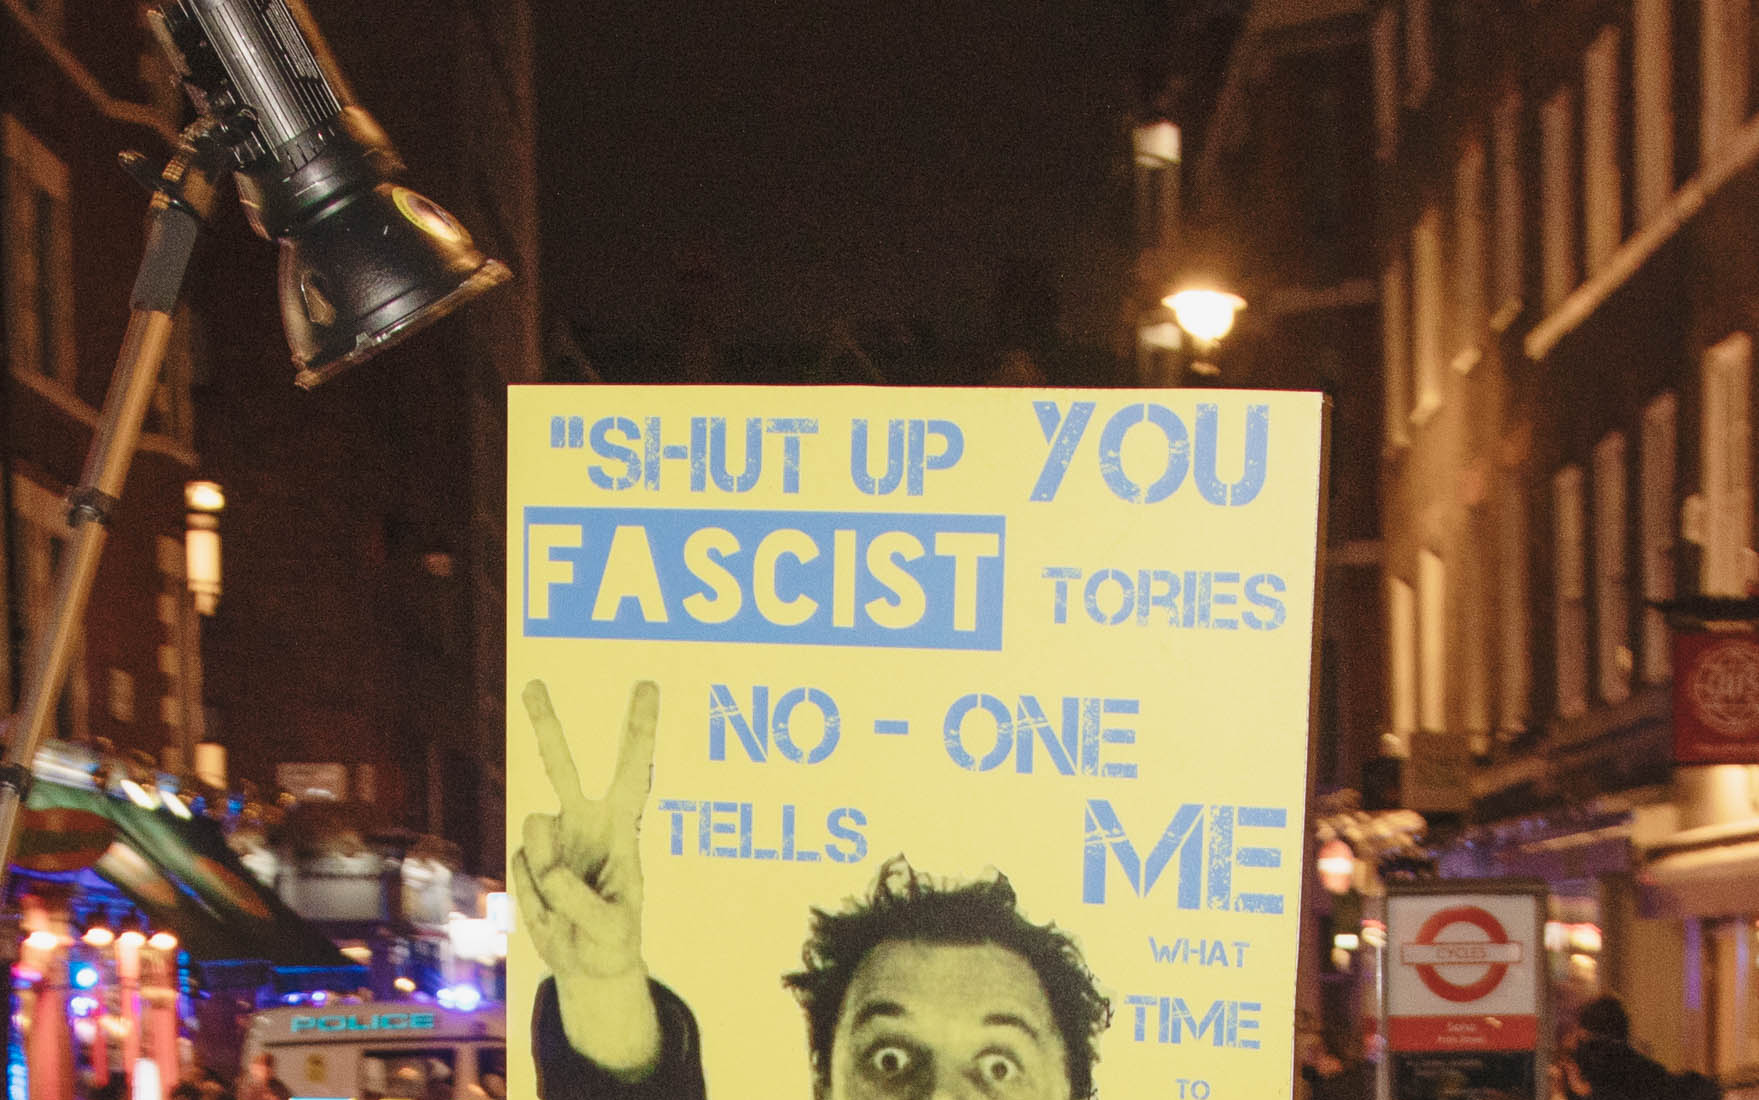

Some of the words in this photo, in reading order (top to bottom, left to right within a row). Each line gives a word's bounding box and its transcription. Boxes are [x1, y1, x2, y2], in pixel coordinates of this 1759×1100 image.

[550, 415, 819, 494] "SHUT
[850, 418, 965, 496] UP
[1030, 401, 1270, 506] YOU
[527, 523, 1000, 632] FASCIST
[1042, 566, 1287, 631] TORIES
[708, 684, 841, 765] NO
[943, 692, 1140, 779] ONE
[658, 799, 868, 863] TELLS
[1083, 798, 1287, 915] ME
[1147, 936, 1250, 968] WHAT
[289, 1012, 435, 1032] POLICE
[1124, 994, 1262, 1049] TIME
[1176, 1078, 1211, 1100] TO
